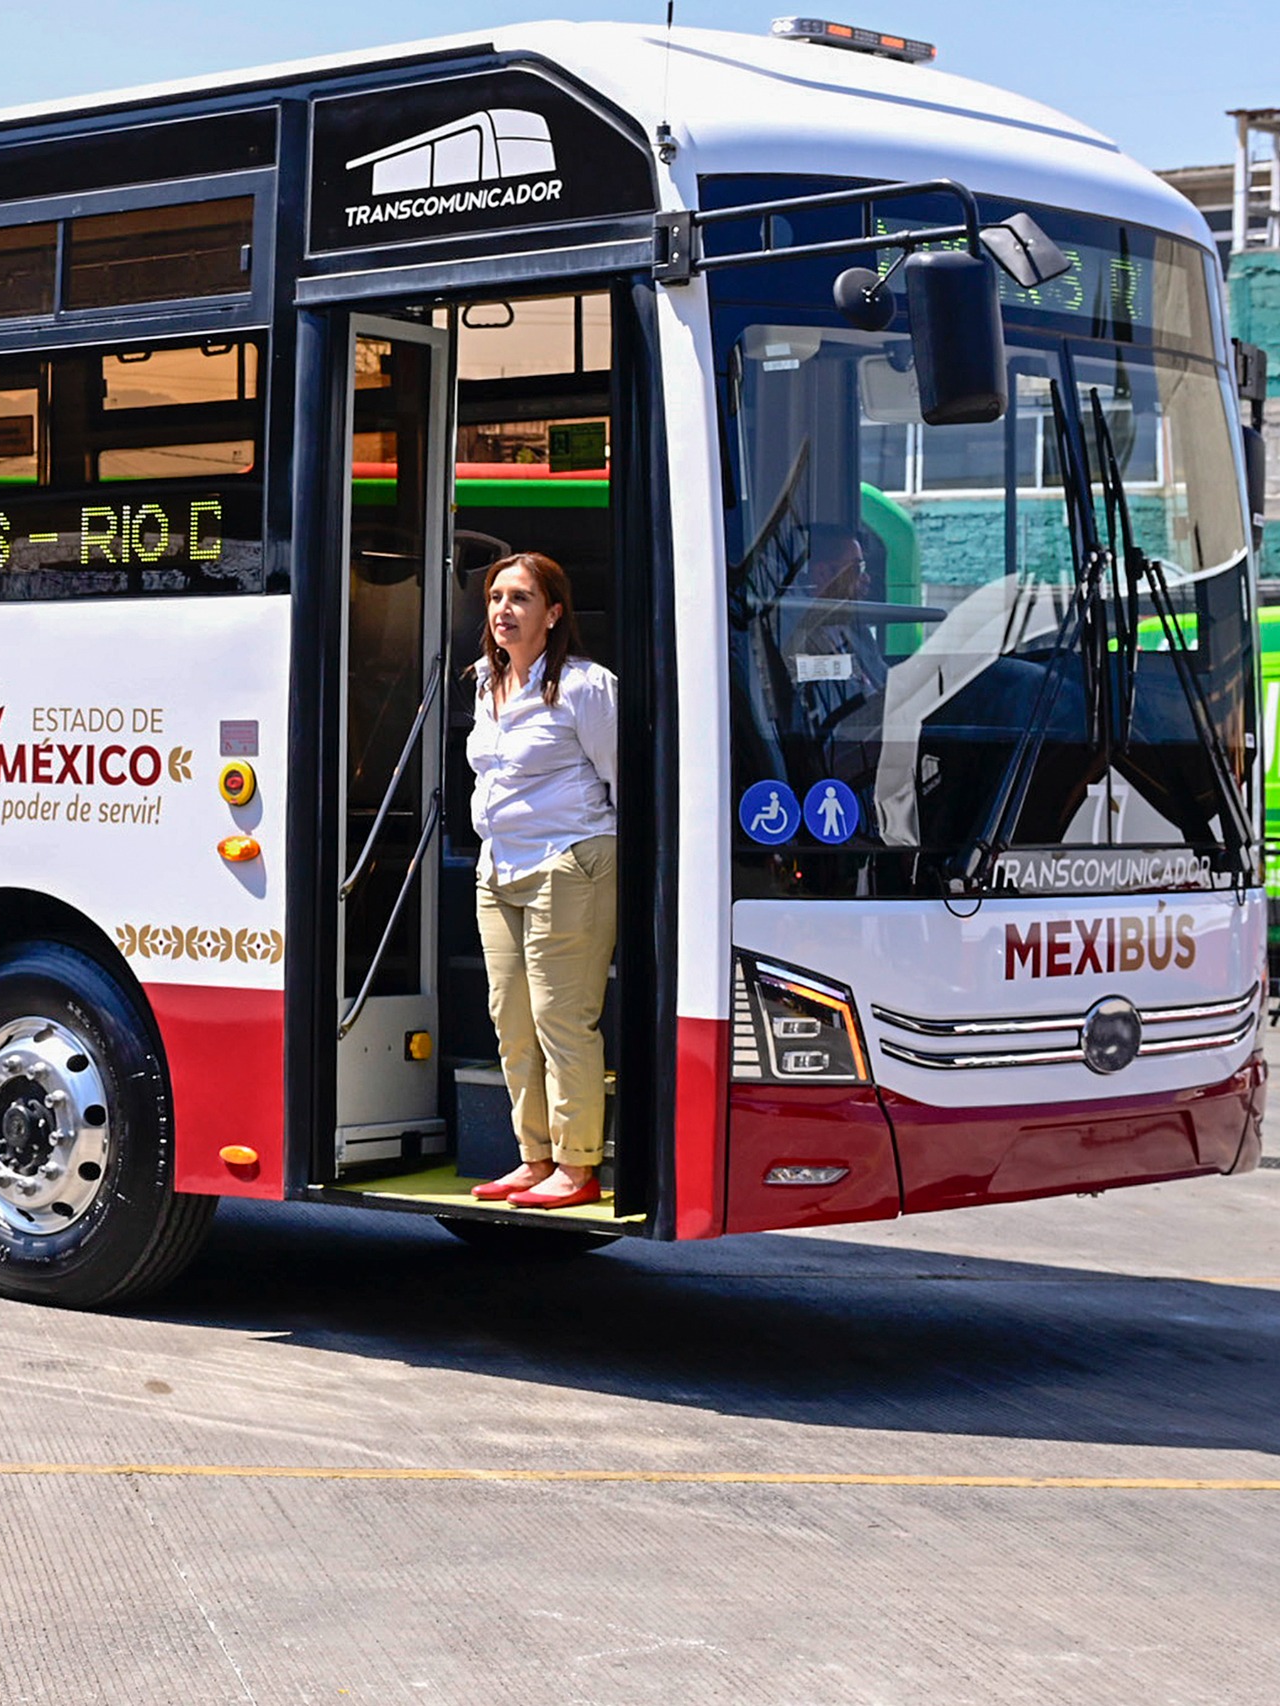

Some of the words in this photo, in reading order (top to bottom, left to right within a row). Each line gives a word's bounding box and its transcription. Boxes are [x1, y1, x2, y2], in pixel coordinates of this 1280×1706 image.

[344, 179, 563, 228] TRANSCOMUNICADOR
[80, 504, 169, 564] RIO
[32, 707, 125, 733] ESTADO
[131, 708, 164, 733] DE
[0, 793, 61, 825] poder
[66, 794, 92, 822] de
[98, 796, 162, 825] servir!
[991, 855, 1211, 889] TRANSCOMUNICADOR
[1004, 900, 1196, 980] MEXIBÚS
